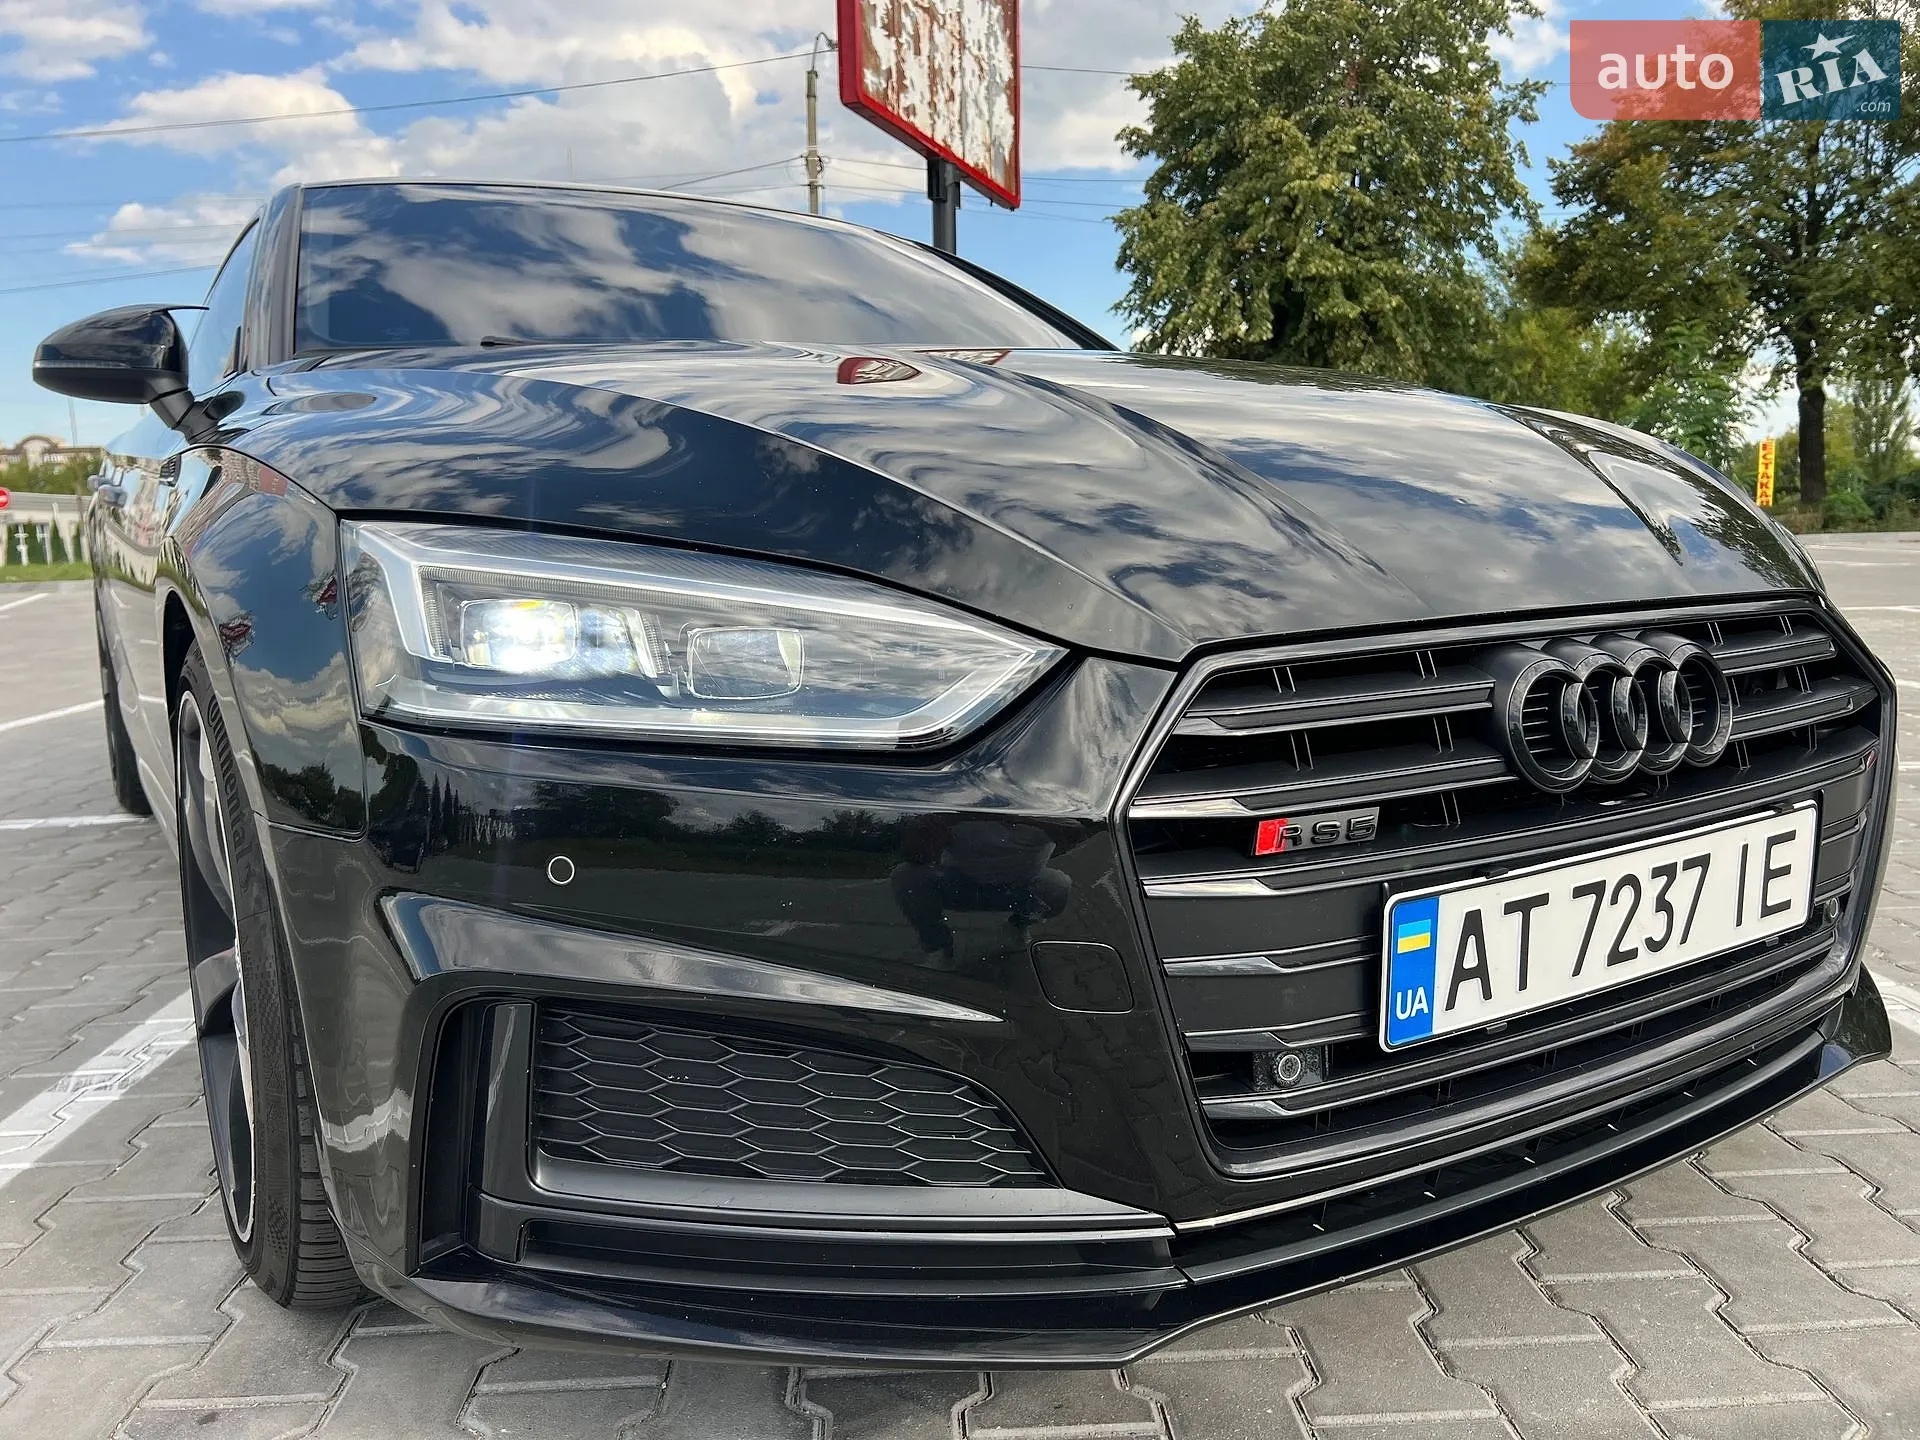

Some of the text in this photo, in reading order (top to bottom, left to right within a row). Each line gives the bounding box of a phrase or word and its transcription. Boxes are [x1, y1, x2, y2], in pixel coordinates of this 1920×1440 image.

[1275, 814, 1377, 848] RS5
[1444, 828, 1797, 1011] AT 7237 IE
[1396, 986, 1429, 1021] UA
